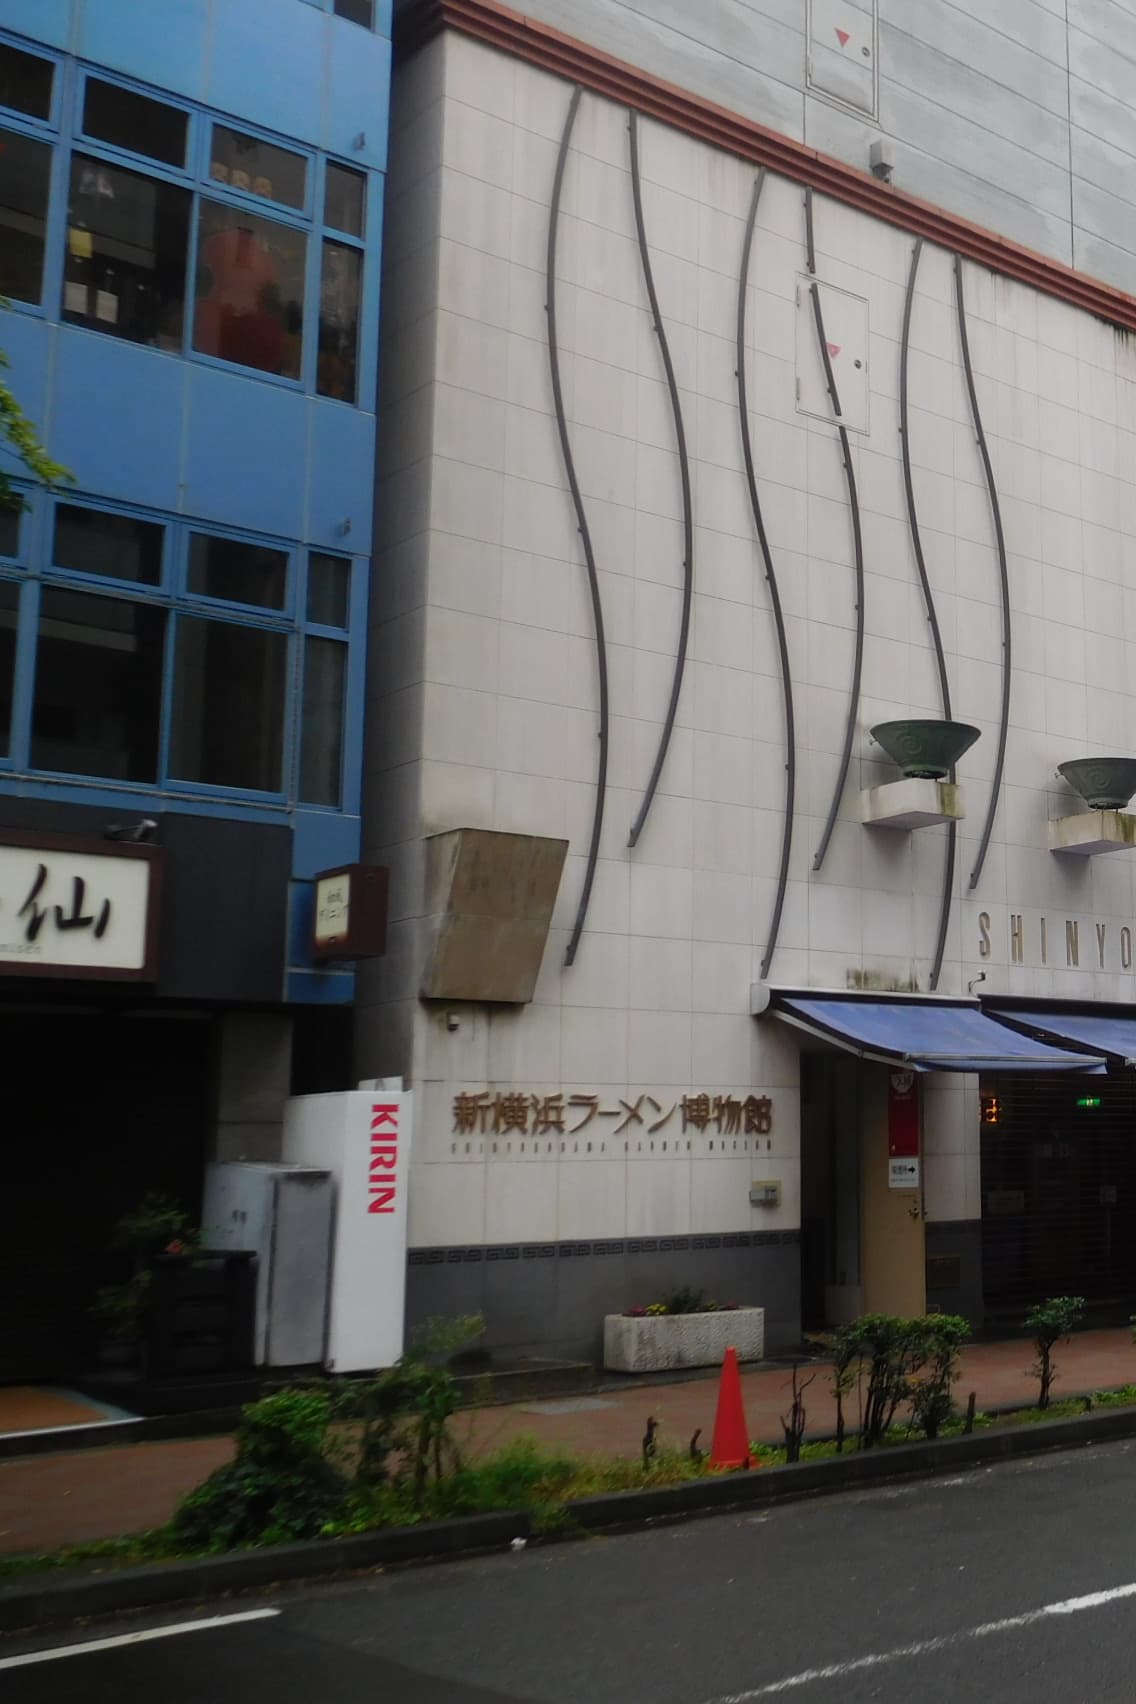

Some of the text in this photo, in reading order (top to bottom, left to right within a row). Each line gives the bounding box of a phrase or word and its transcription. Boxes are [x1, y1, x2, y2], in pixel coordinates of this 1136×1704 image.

[452, 1091, 773, 1136] 新横浜ラーメン博物館
[367, 1103, 400, 1214] KIRIN
